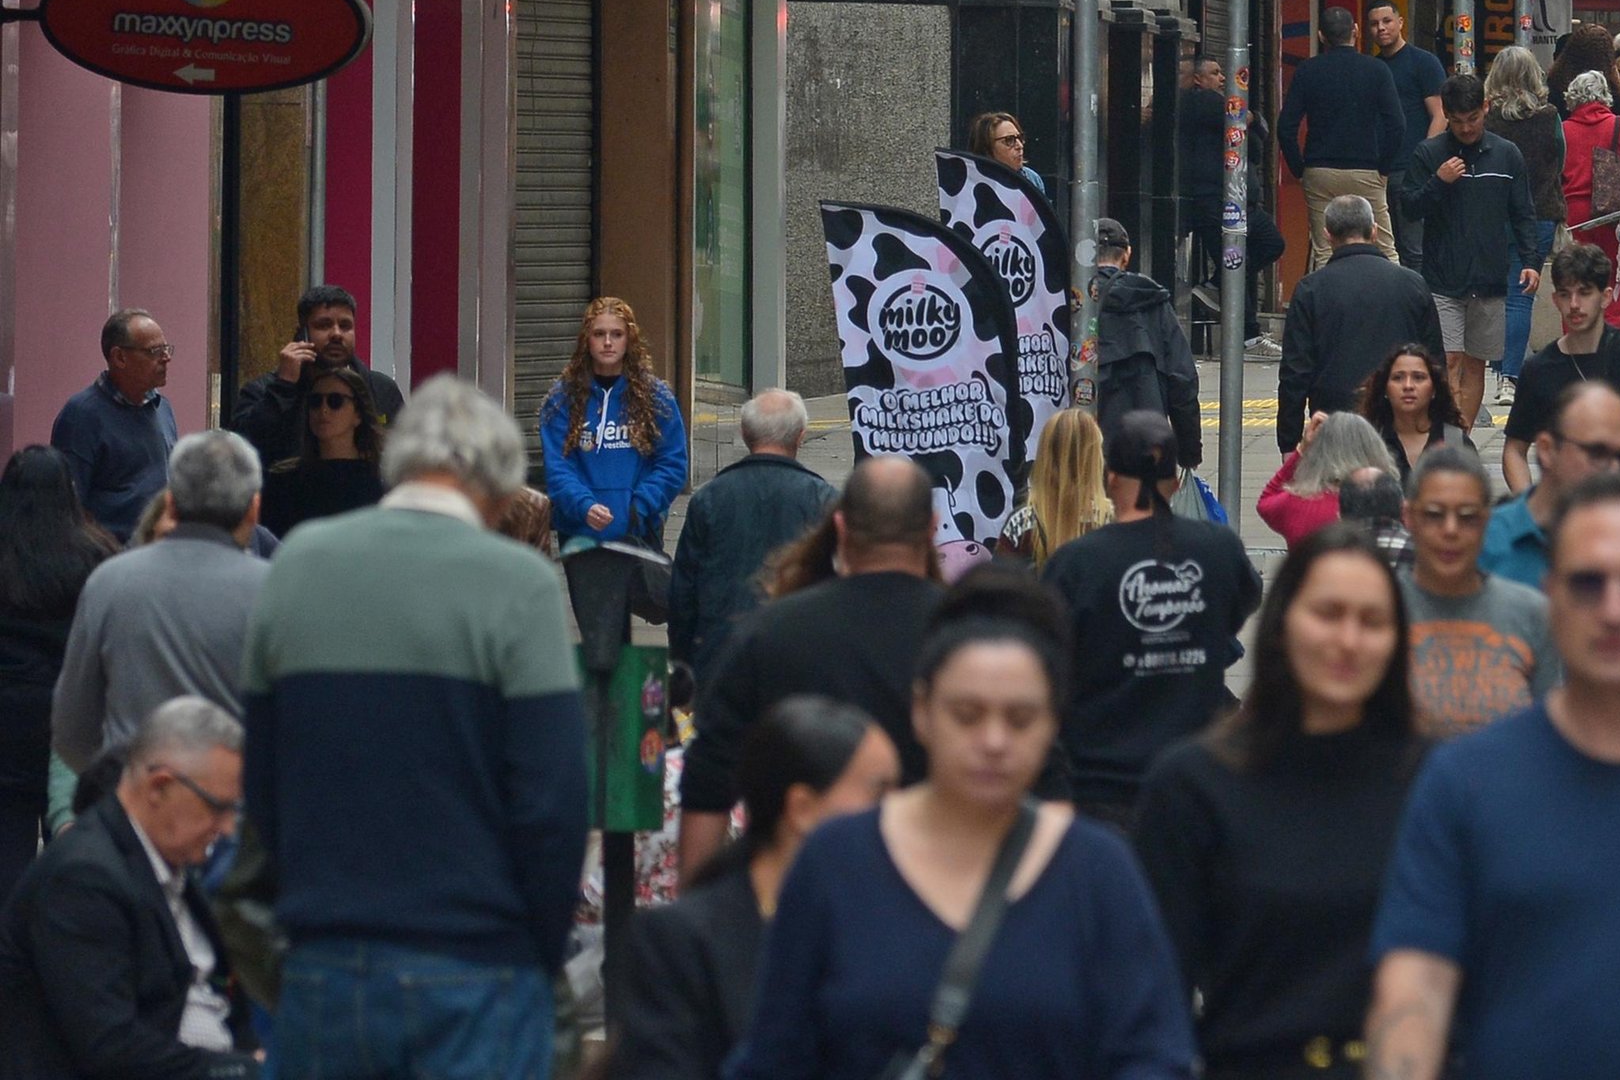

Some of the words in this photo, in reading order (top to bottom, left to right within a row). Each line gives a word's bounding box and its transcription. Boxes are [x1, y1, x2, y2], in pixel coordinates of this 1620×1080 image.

[113, 12, 292, 44] maxxynpress
[990, 245, 1036, 280] ilky
[879, 294, 961, 330] milky
[884, 326, 947, 351] moo
[881, 391, 898, 410] O
[901, 381, 985, 411] MELHOR
[859, 403, 975, 430] MILKSHAKE
[978, 402, 1005, 428] DO
[603, 441, 631, 449] vestibu
[871, 422, 996, 450] MUUUNDO!!!
